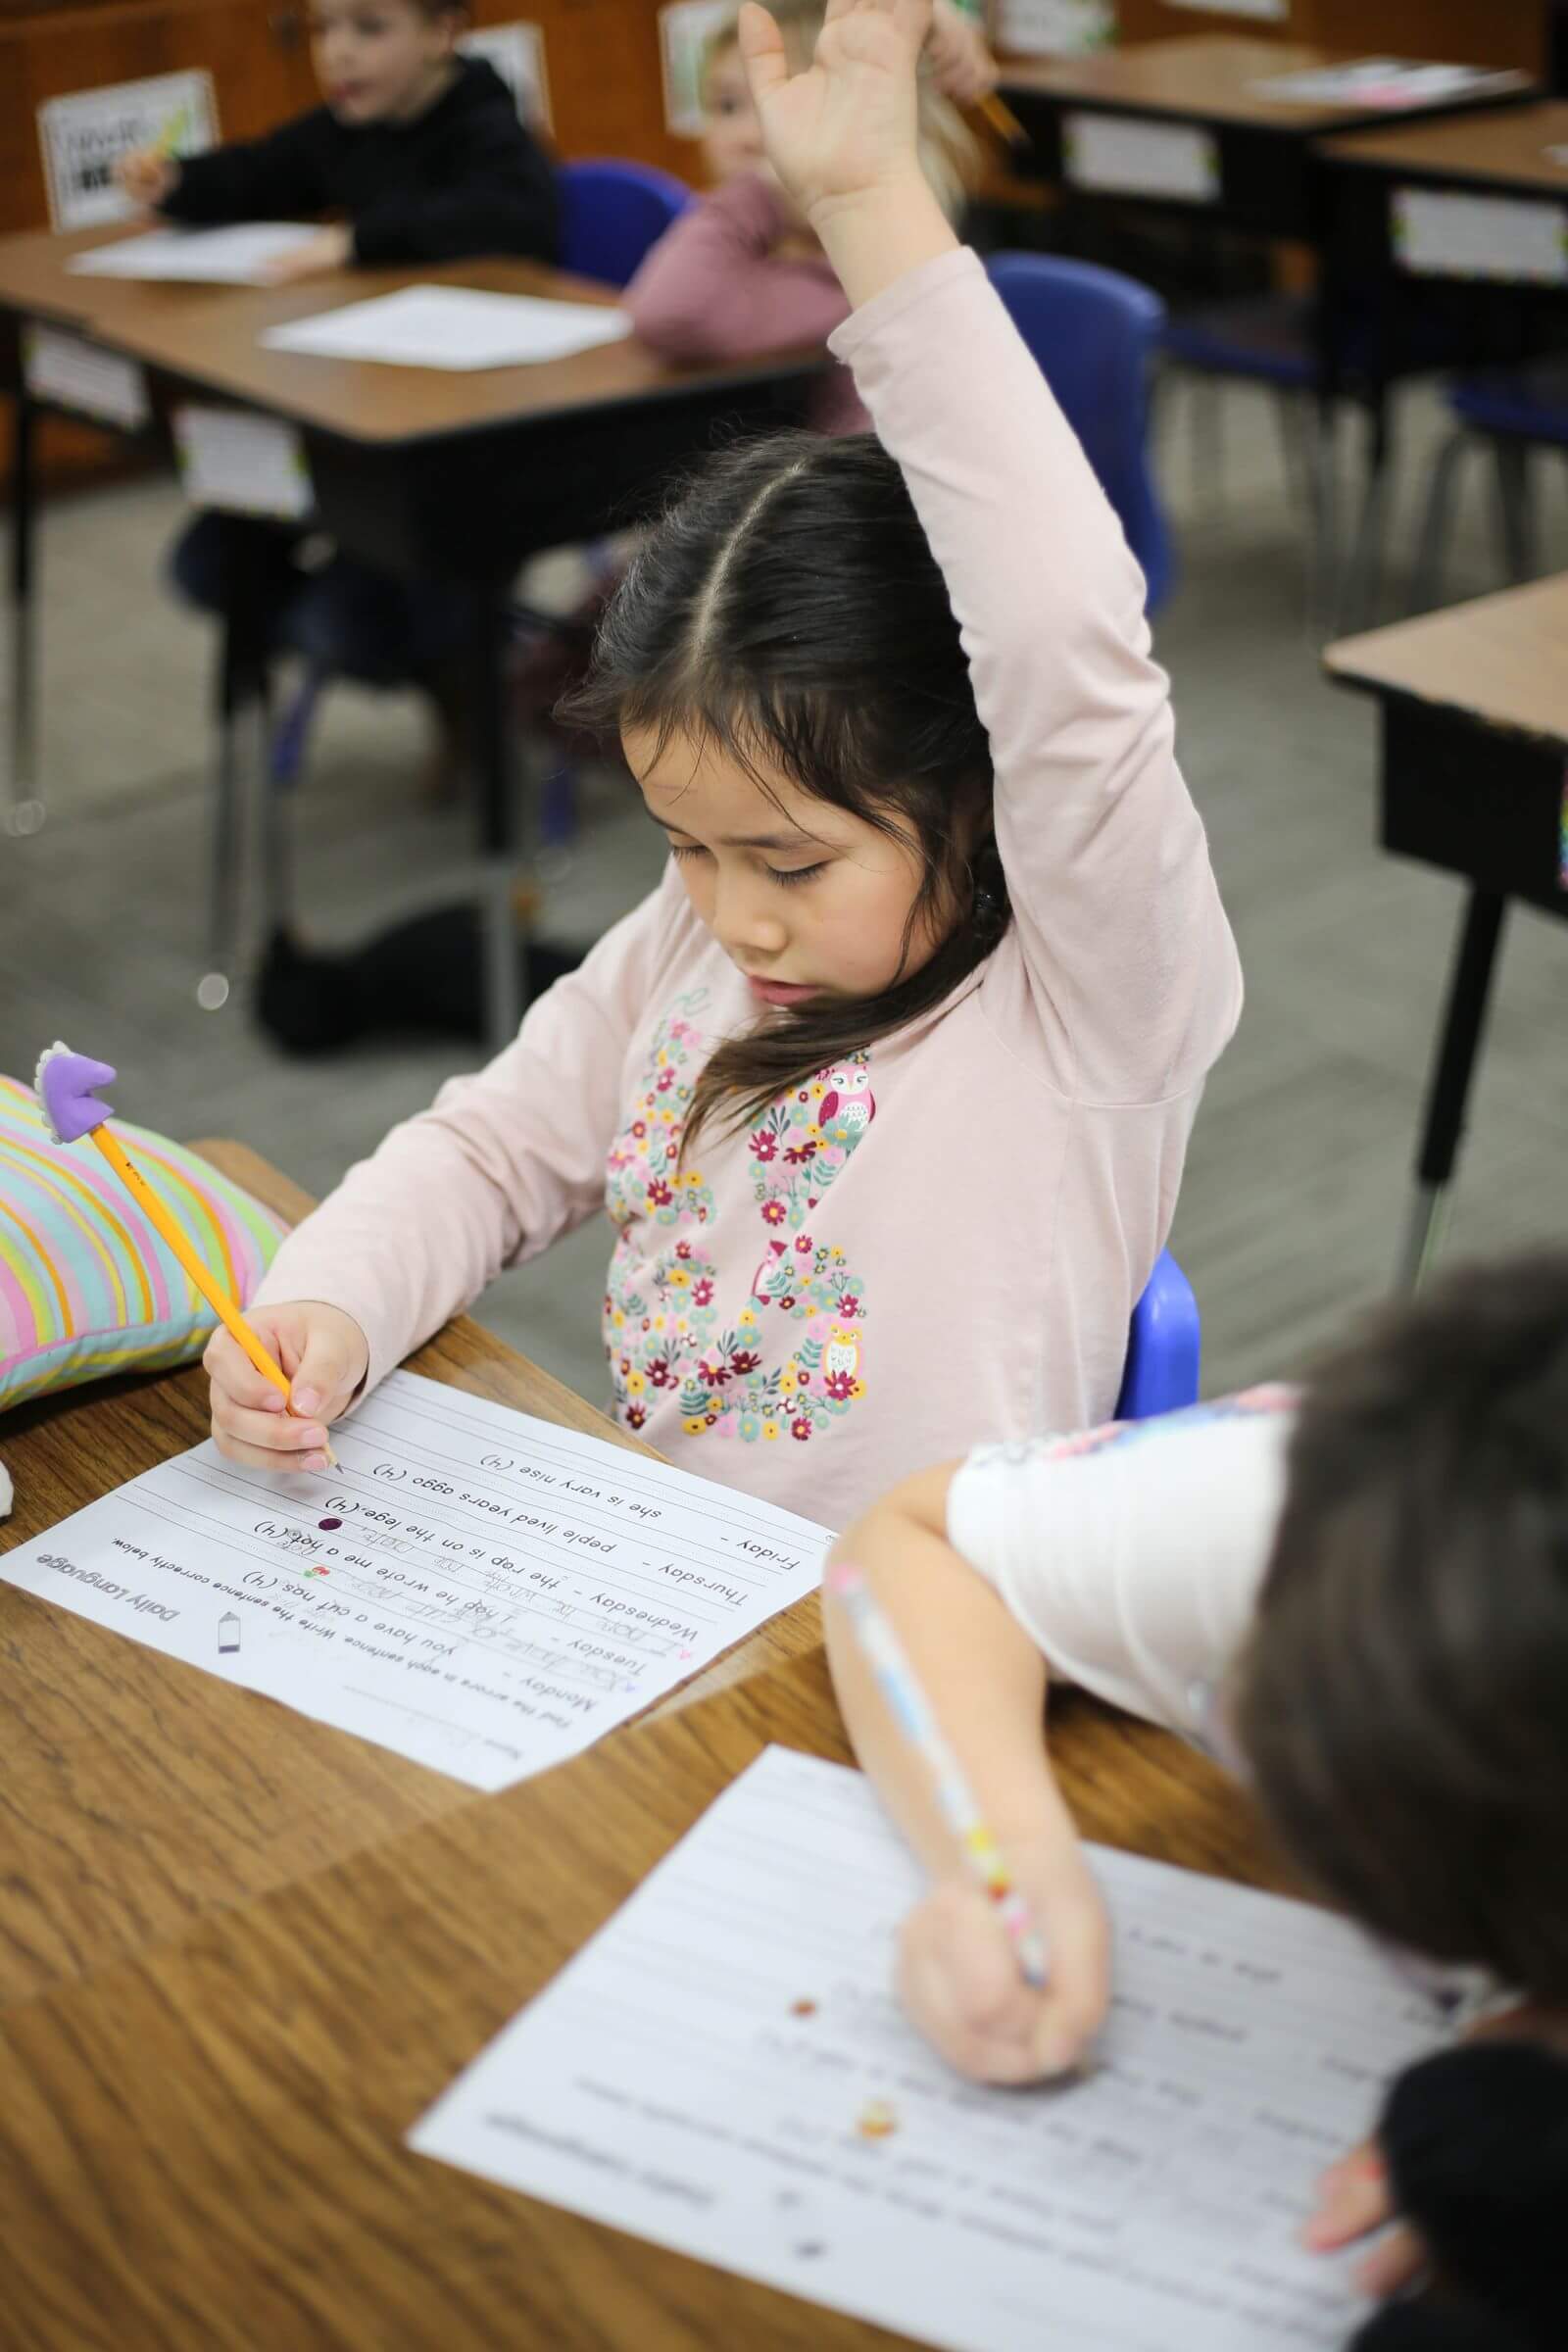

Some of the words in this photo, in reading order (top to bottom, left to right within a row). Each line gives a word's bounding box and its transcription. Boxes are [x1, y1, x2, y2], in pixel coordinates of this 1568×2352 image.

[479, 1454, 514, 1471] (4)
[372, 1463, 407, 1481] (4)
[518, 1466, 557, 1485] nise
[412, 1477, 454, 1495] aggo
[559, 1480, 601, 1498] vary
[325, 1496, 360, 1515] (4)
[459, 1494, 513, 1517] years
[607, 1495, 625, 1506] is
[628, 1503, 662, 1518] she
[254, 1521, 288, 1539] (4)
[406, 1525, 436, 1543] the
[509, 1514, 558, 1536] lived
[111, 1538, 150, 1561] below.
[441, 1540, 464, 1551] on
[563, 1530, 617, 1553] peple
[344, 1554, 372, 1569] me
[468, 1548, 487, 1559] is
[736, 1540, 801, 1570] Friday
[36, 1553, 130, 1601] Language
[149, 1556, 211, 1585] correctly
[242, 1572, 278, 1589] (4)
[375, 1568, 429, 1592] wrote
[529, 1572, 562, 1590] the
[658, 1563, 749, 1606] Thursday
[213, 1582, 270, 1608] sentence
[435, 1592, 460, 1607] he
[124, 1593, 181, 1623] Daily
[272, 1606, 295, 1622] the
[316, 1602, 351, 1616] cut
[589, 1592, 699, 1642] Wednesday
[355, 1614, 368, 1623] a
[298, 1619, 337, 1641] Write
[373, 1623, 416, 1646] have
[420, 1639, 458, 1656] you
[566, 1639, 647, 1676] Tuesday
[520, 1678, 597, 1712] Monday
